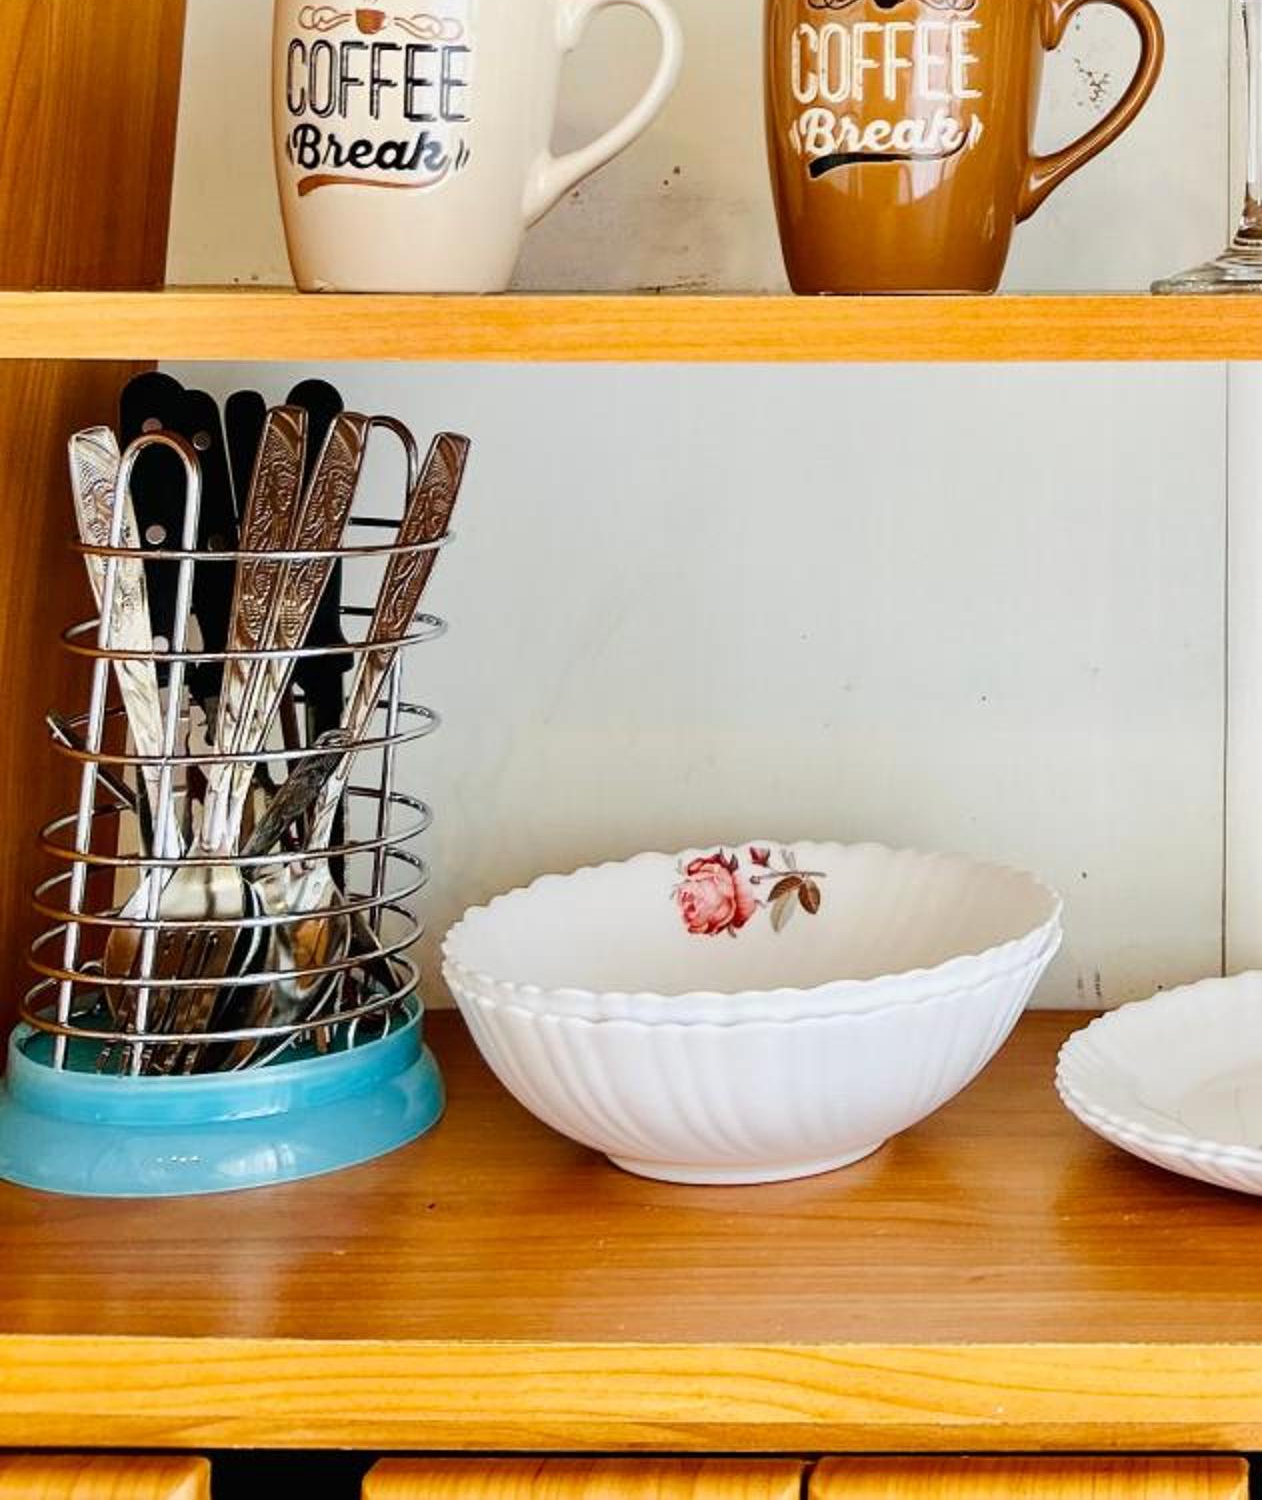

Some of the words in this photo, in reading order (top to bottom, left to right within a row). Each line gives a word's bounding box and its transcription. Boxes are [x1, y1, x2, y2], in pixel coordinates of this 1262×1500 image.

[287, 38, 471, 123] COFFEE
[790, 20, 982, 104] COFFEE
[292, 123, 449, 172] Break
[801, 107, 964, 156] Break
